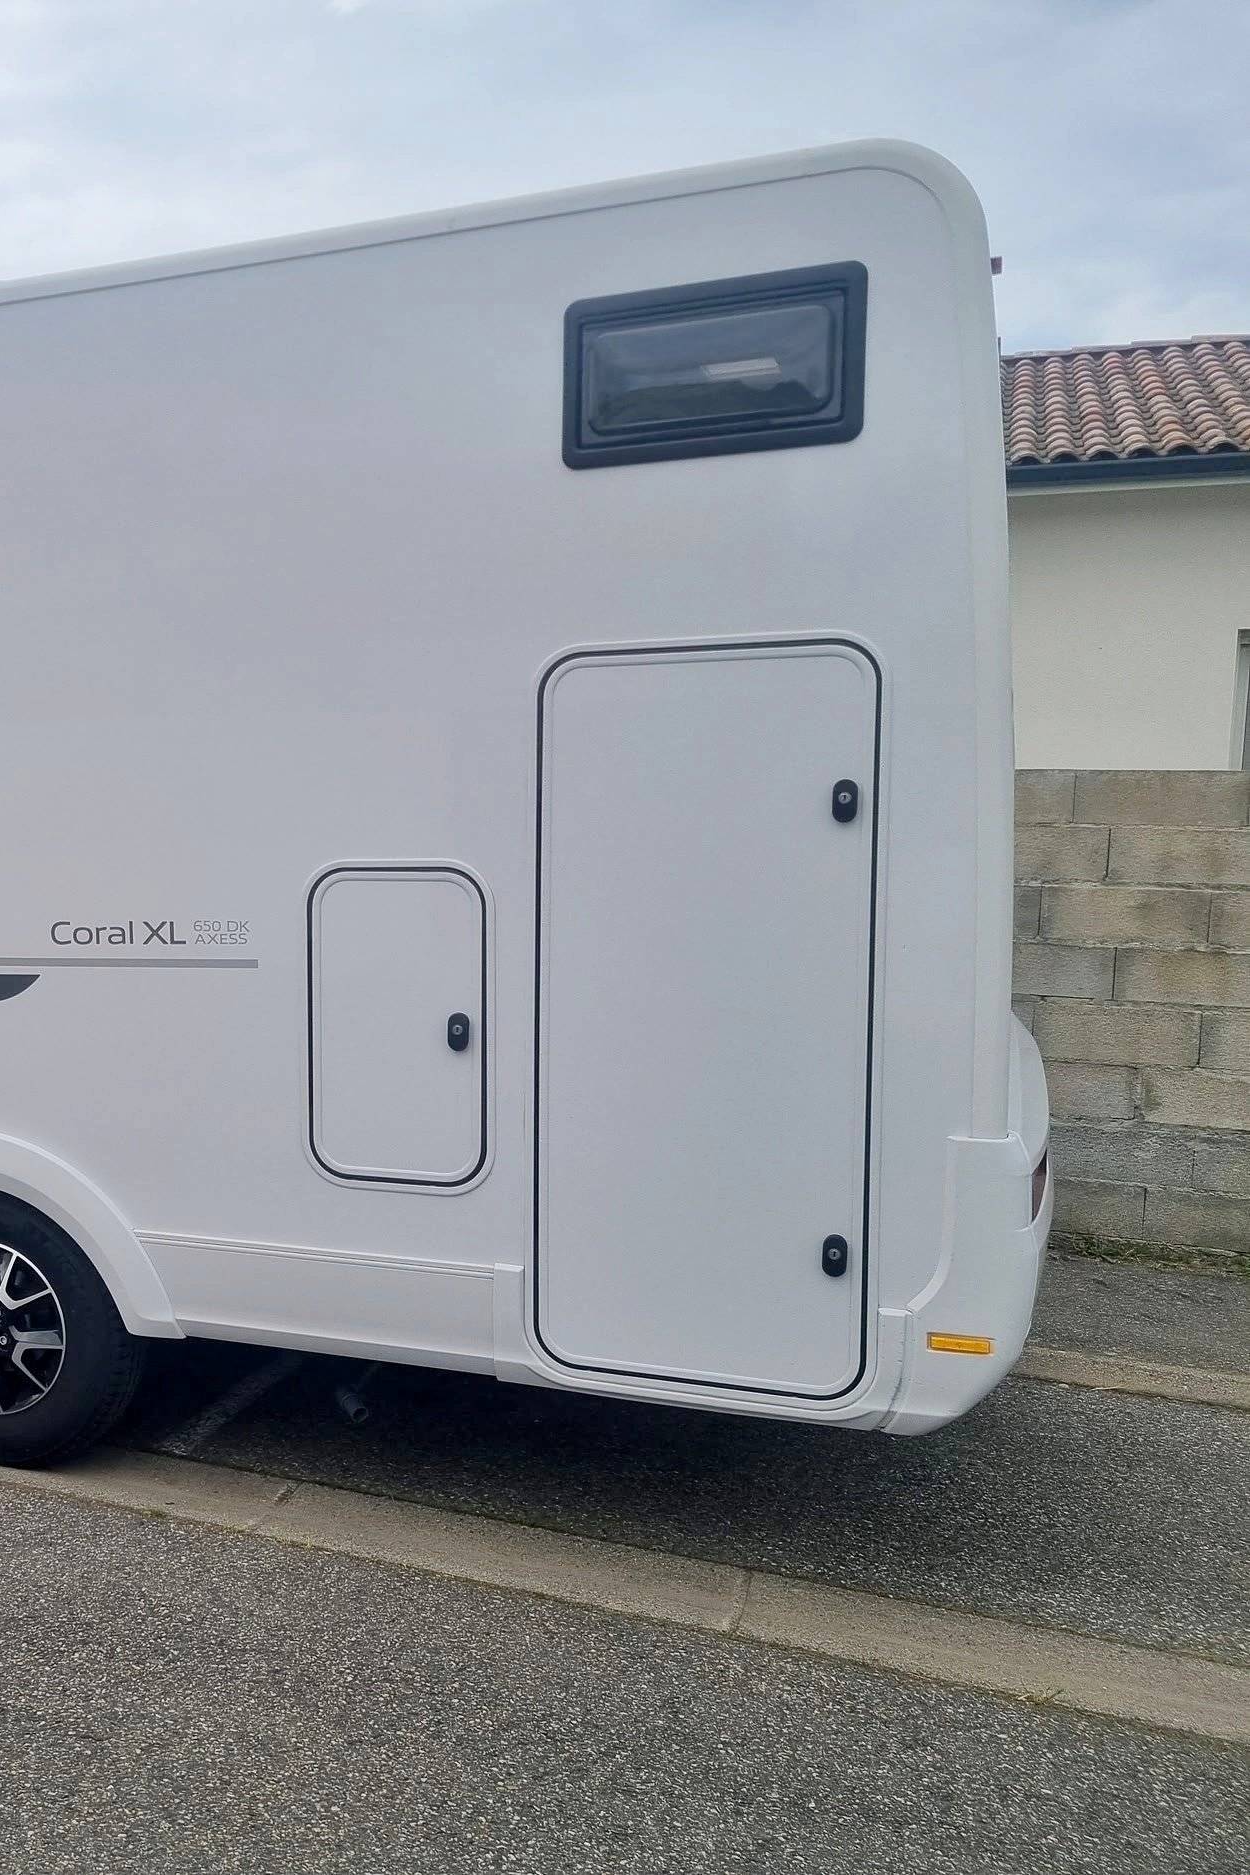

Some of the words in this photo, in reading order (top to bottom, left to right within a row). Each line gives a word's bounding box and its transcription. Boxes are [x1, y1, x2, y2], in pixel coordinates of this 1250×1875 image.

[193, 920, 222, 932] 650
[227, 920, 250, 932] DK
[50, 920, 134, 945] Coral
[142, 920, 187, 945] XL
[194, 933, 248, 945] AXESS
